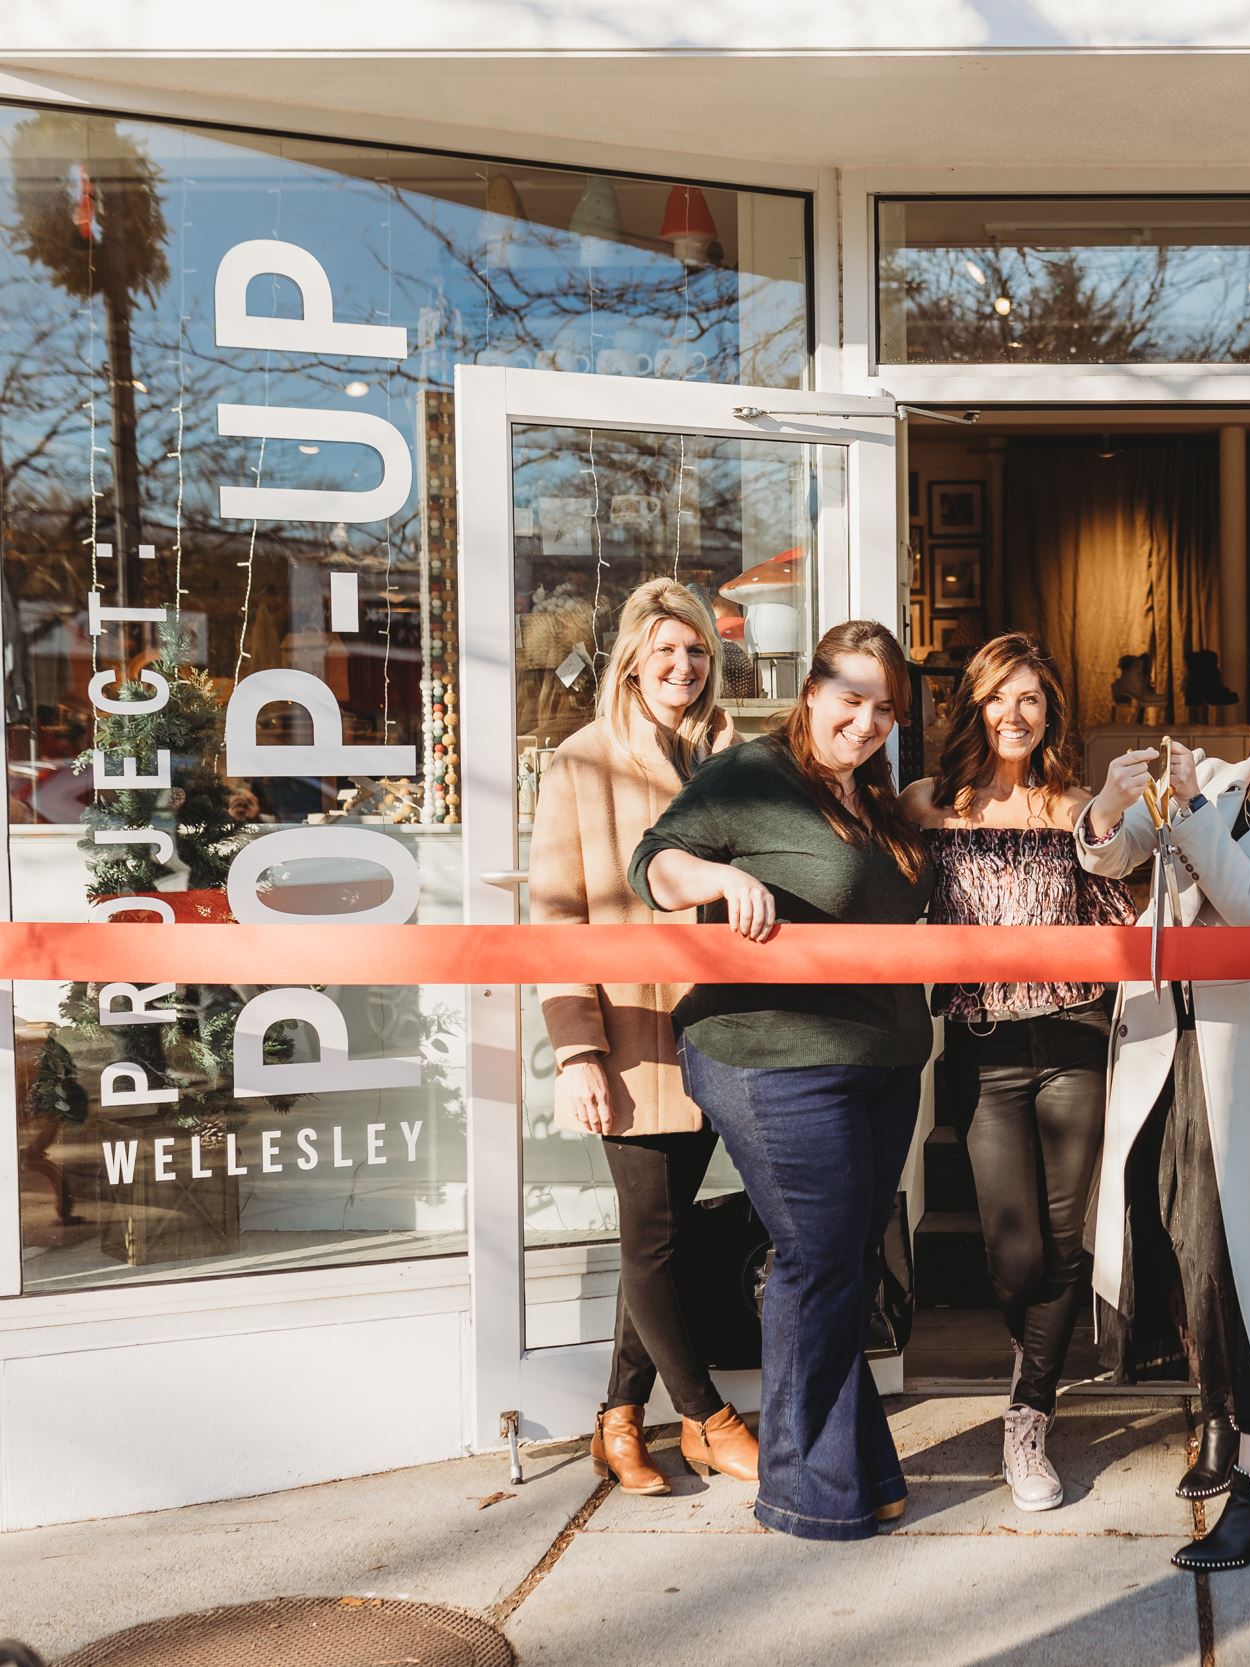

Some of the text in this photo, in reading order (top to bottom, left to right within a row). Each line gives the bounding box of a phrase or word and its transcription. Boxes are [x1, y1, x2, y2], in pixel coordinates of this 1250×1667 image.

[88, 542, 180, 1107] PROJECT:
[214, 238, 422, 1098] POP-UP
[102, 1119, 424, 1186] WELLESLEY
